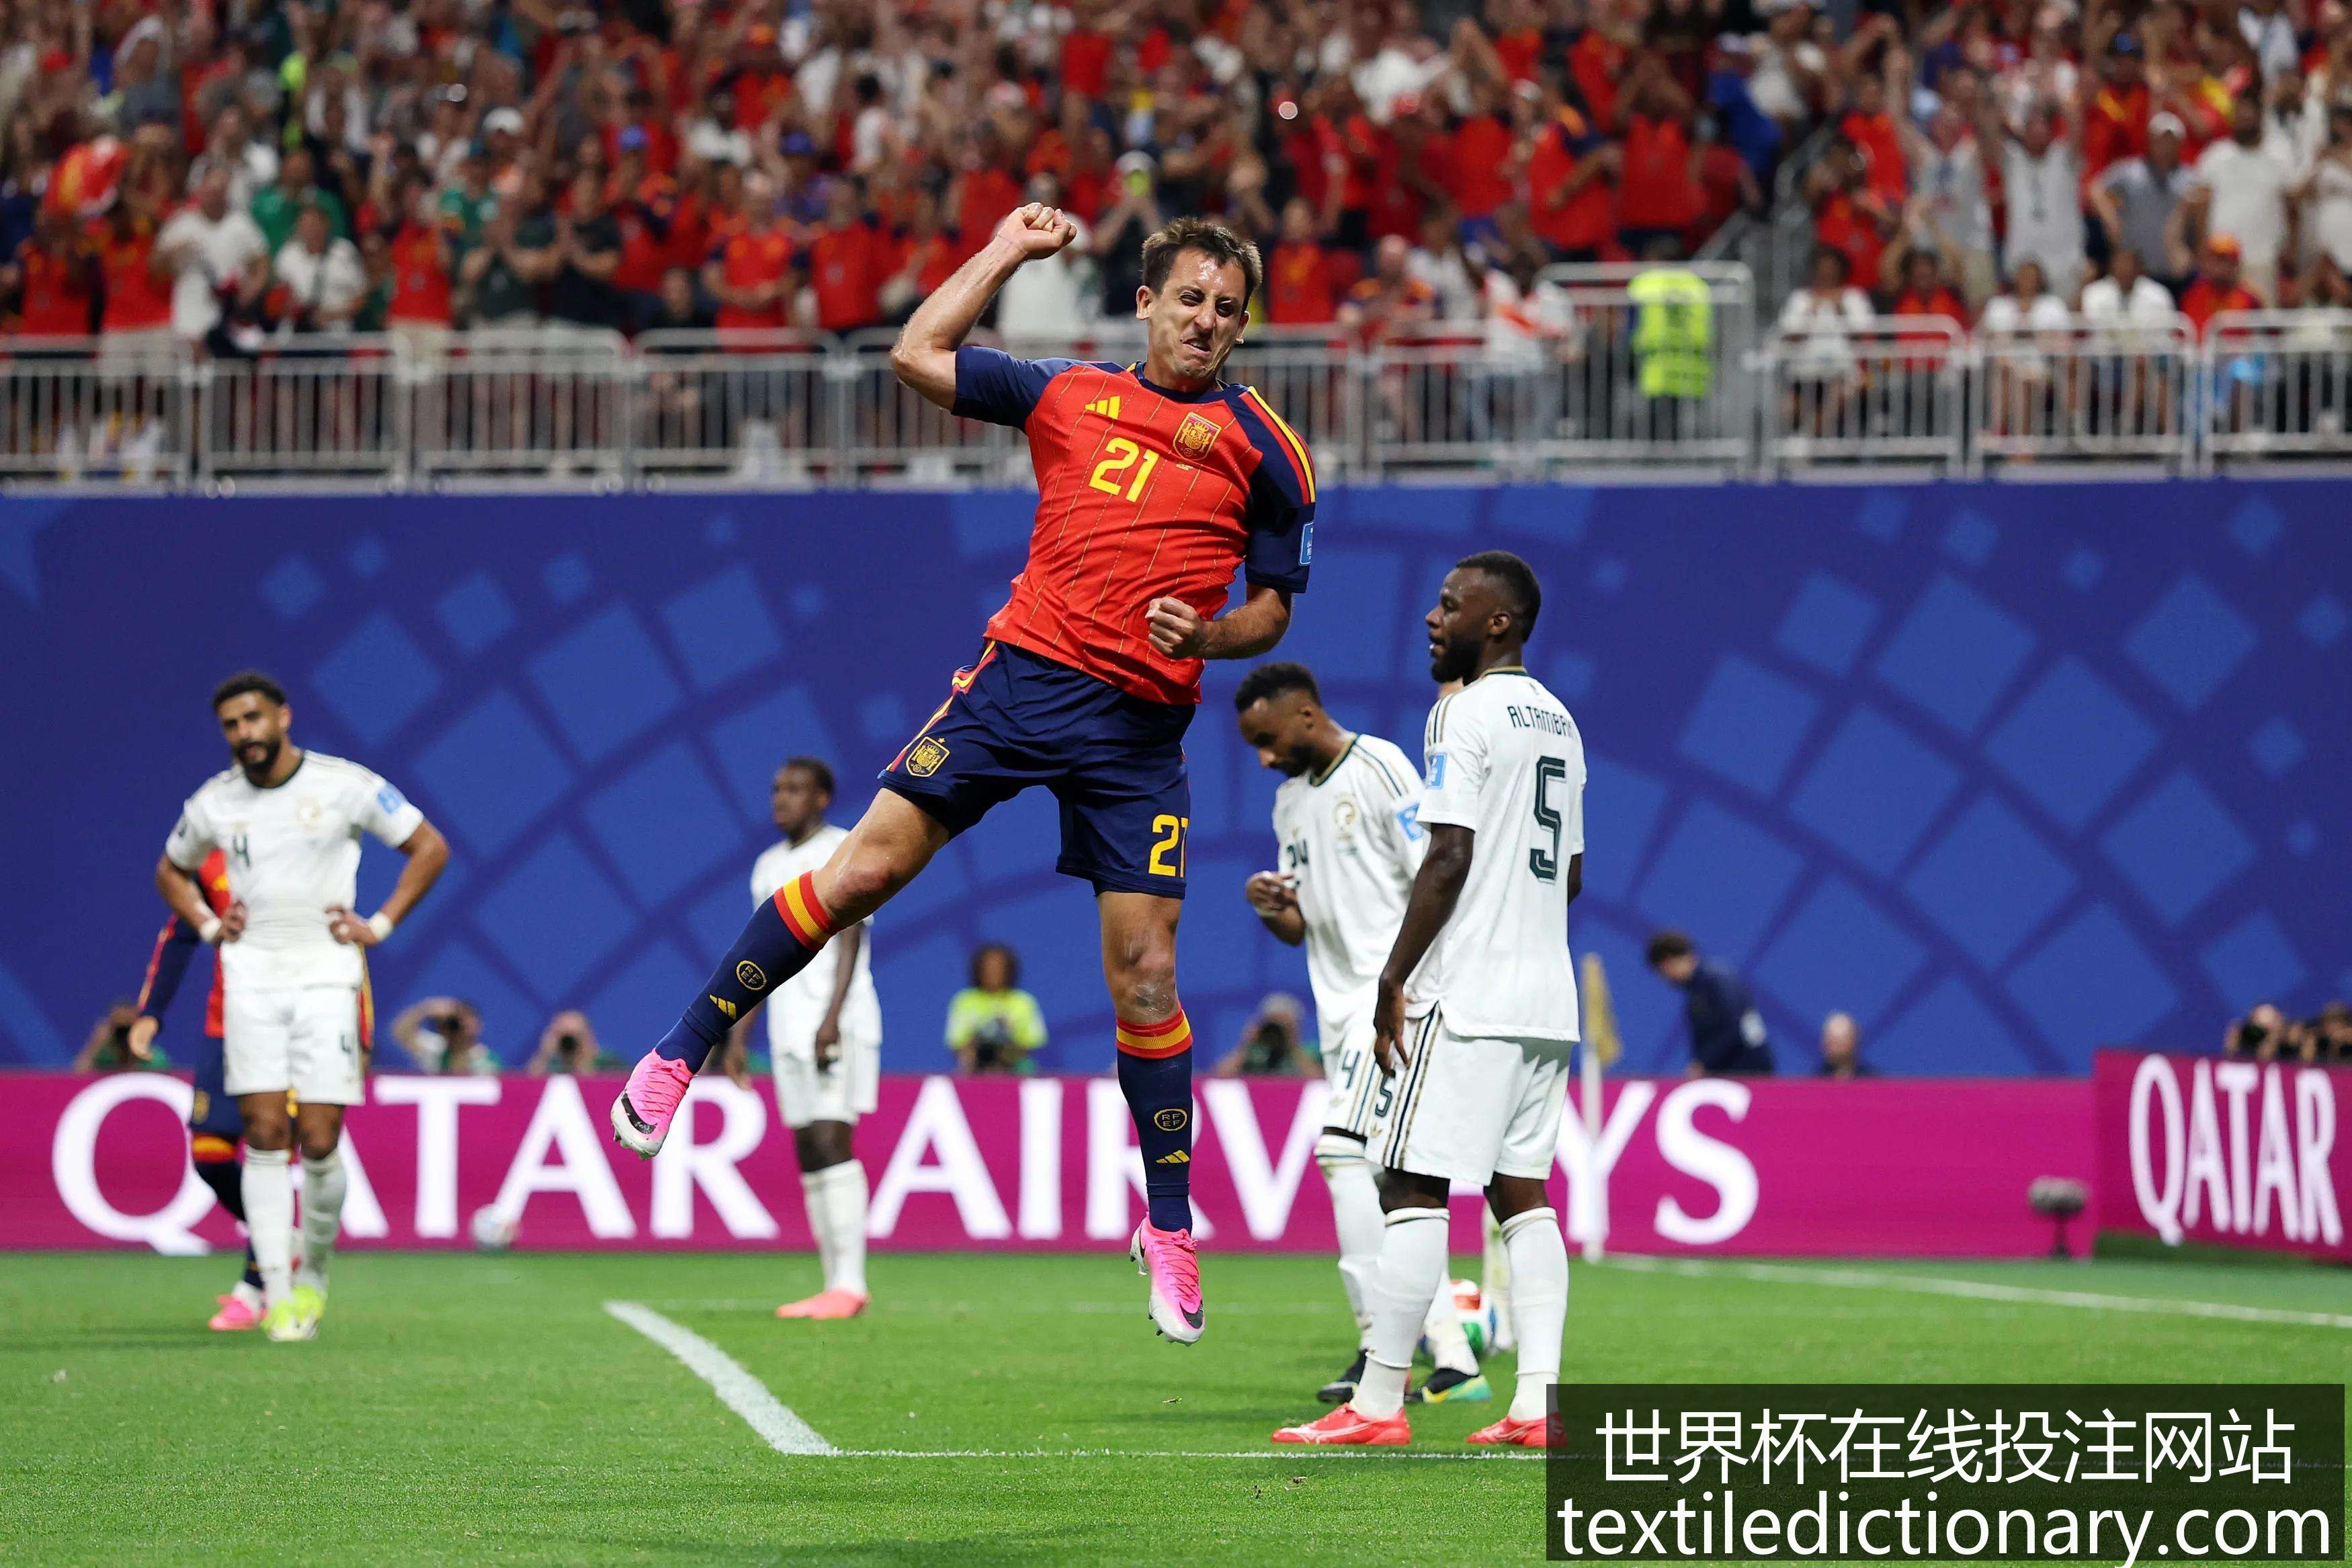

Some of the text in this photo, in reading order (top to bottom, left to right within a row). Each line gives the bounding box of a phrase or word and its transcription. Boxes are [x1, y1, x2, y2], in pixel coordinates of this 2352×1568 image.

[1089, 437, 1159, 503] 21
[1148, 814, 1189, 878] 21
[1529, 756, 1566, 883] 5
[231, 835, 251, 870] 4
[1374, 1068, 1396, 1118] 5
[2129, 1053, 2345, 1246] QATAR
